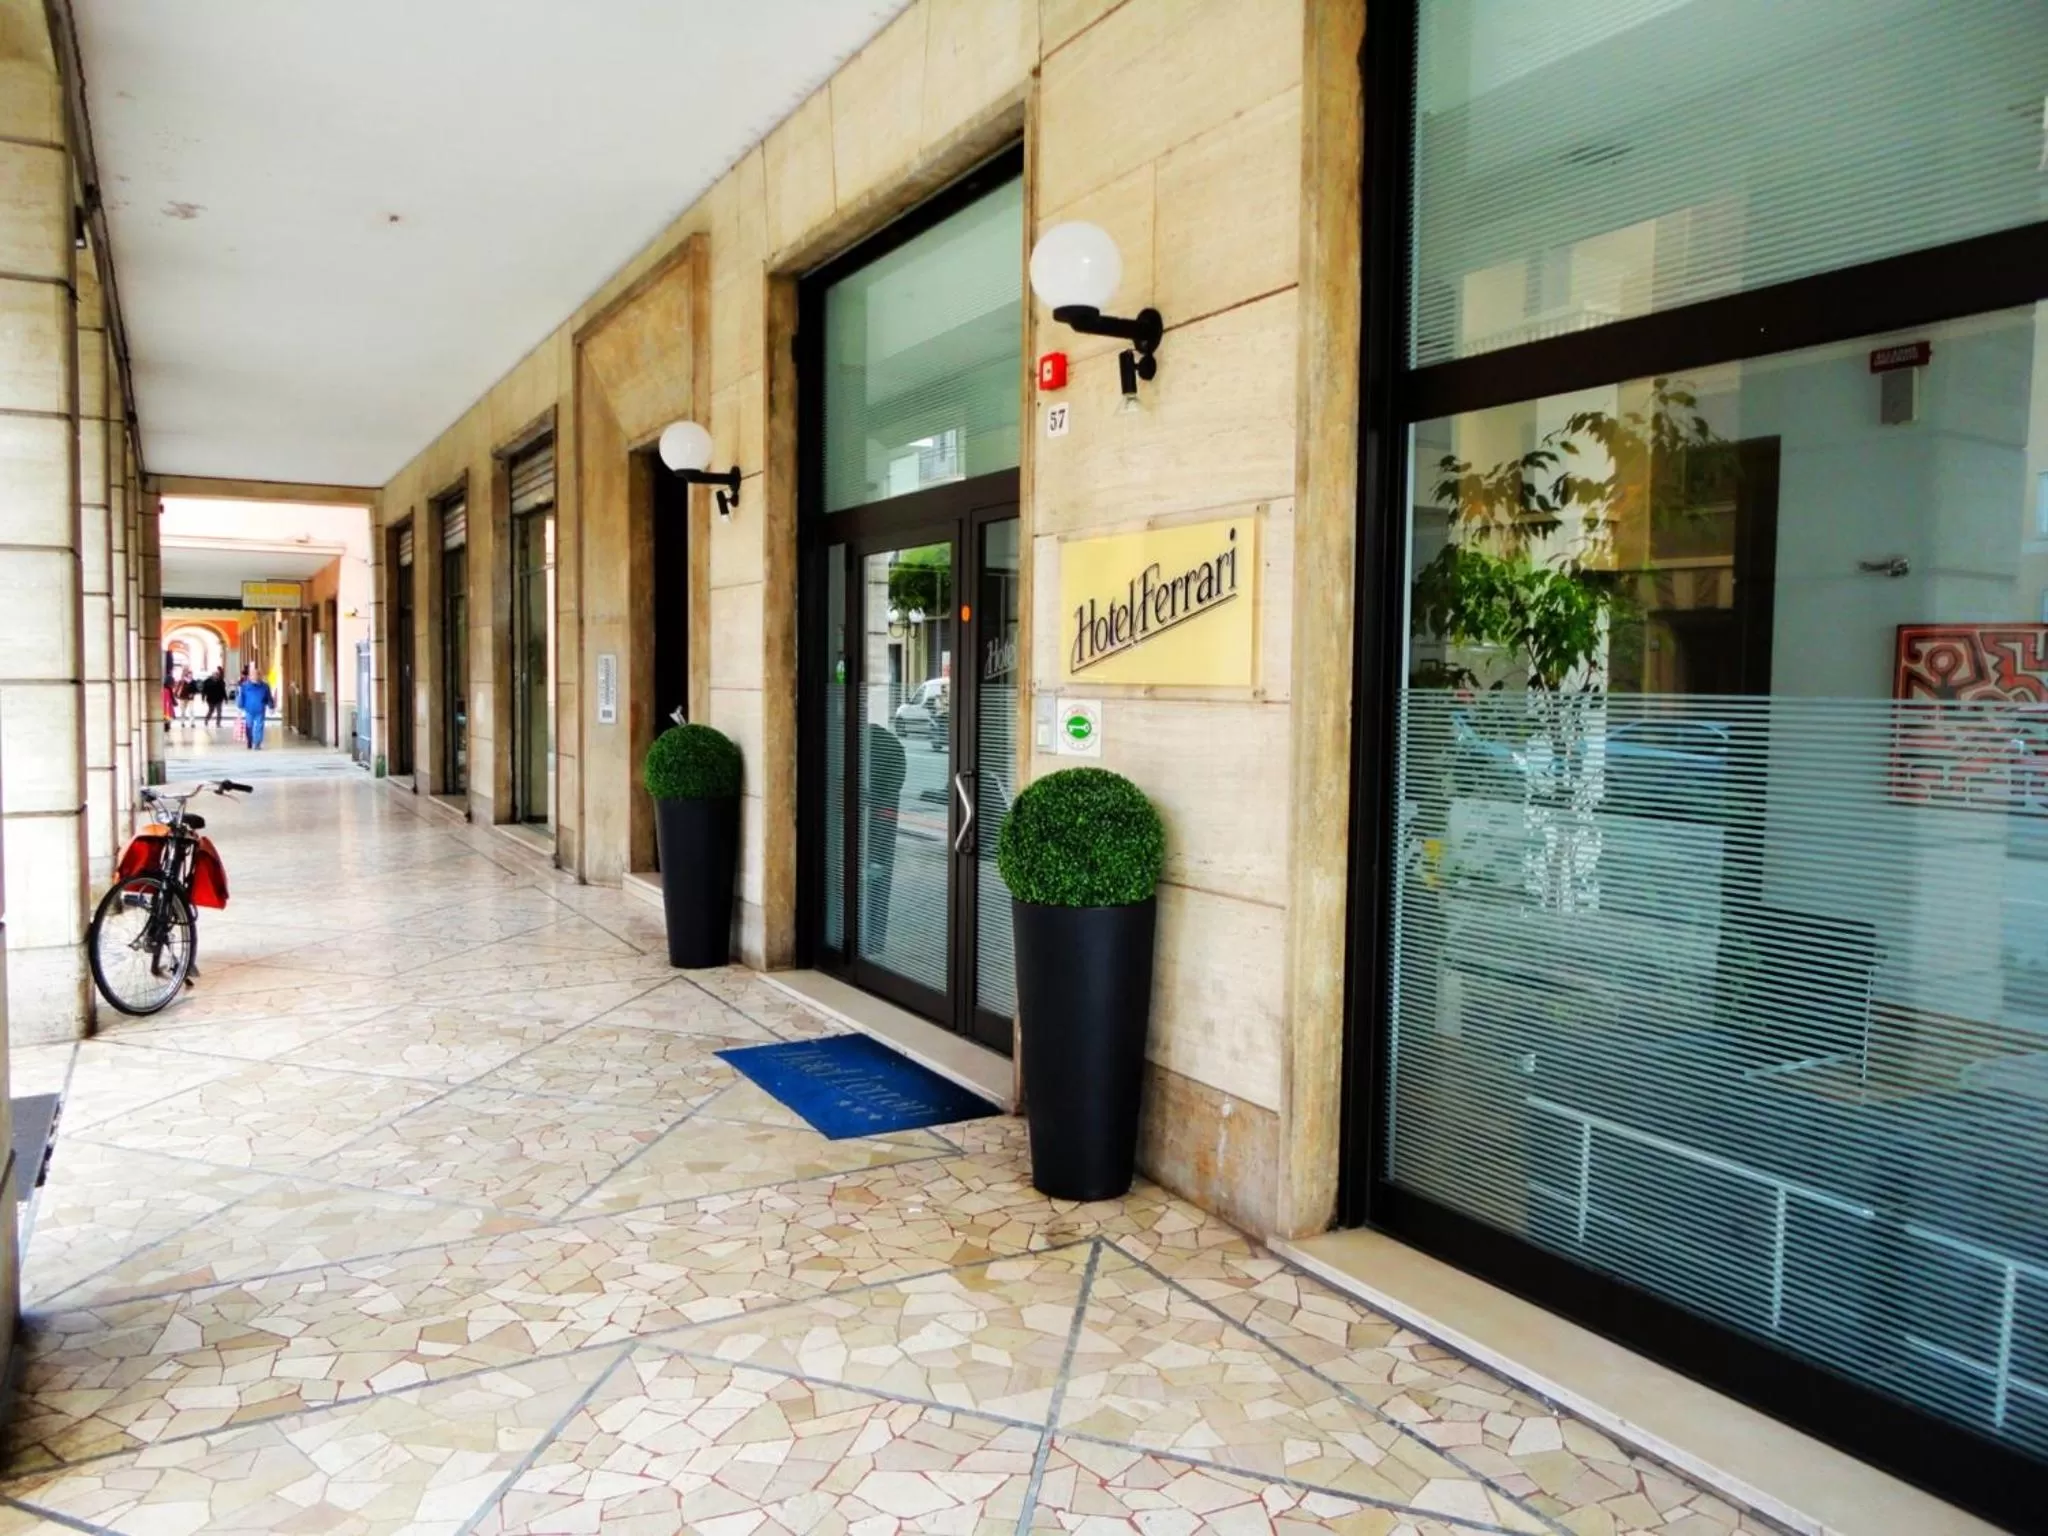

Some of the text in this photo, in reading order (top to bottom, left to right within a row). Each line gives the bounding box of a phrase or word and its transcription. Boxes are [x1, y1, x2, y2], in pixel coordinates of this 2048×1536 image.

[1050, 408, 1066, 431] 57
[1072, 527, 1237, 670] Hotel Ferrari
